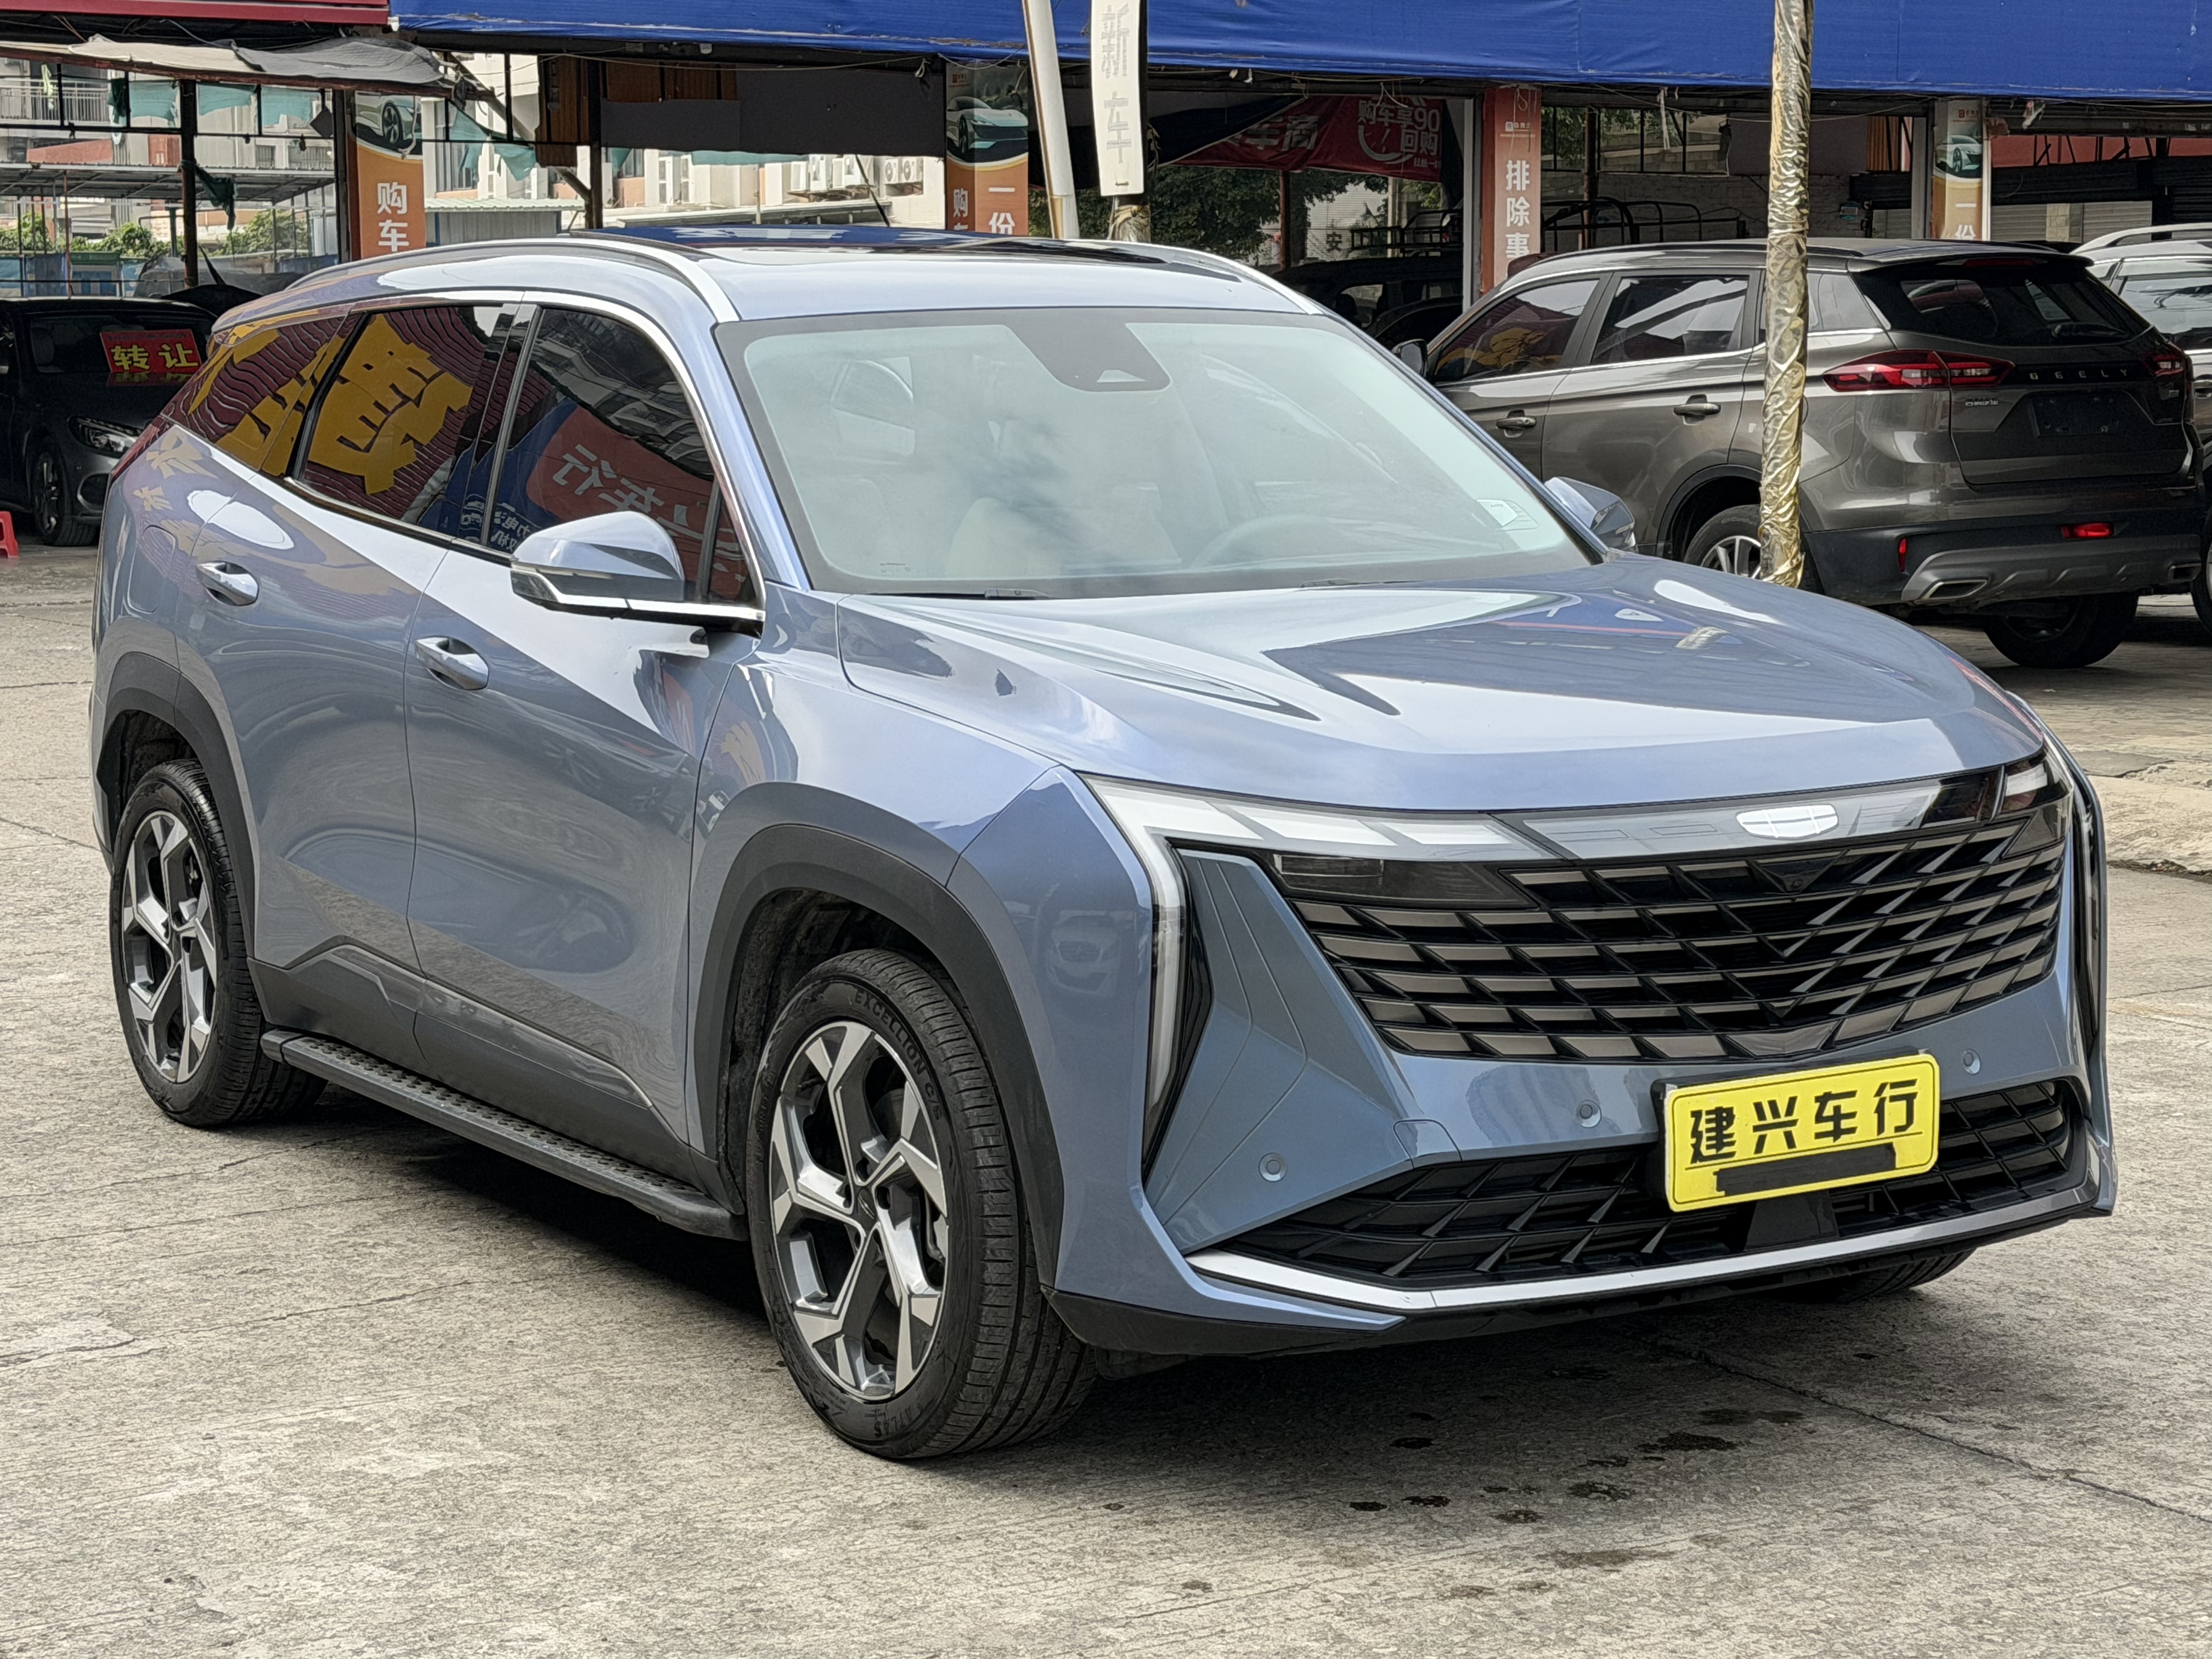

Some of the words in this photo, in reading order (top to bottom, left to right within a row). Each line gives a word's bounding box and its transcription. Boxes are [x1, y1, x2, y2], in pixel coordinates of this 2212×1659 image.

[1400, 128, 1438, 156] 回购
[377, 182, 410, 252] 购车
[953, 188, 969, 230] 购
[1505, 160, 1530, 258] 排除事
[110, 343, 199, 370] 转让
[2029, 369, 2128, 380] GEELY
[1690, 1078, 1918, 1164] 建兴车行
